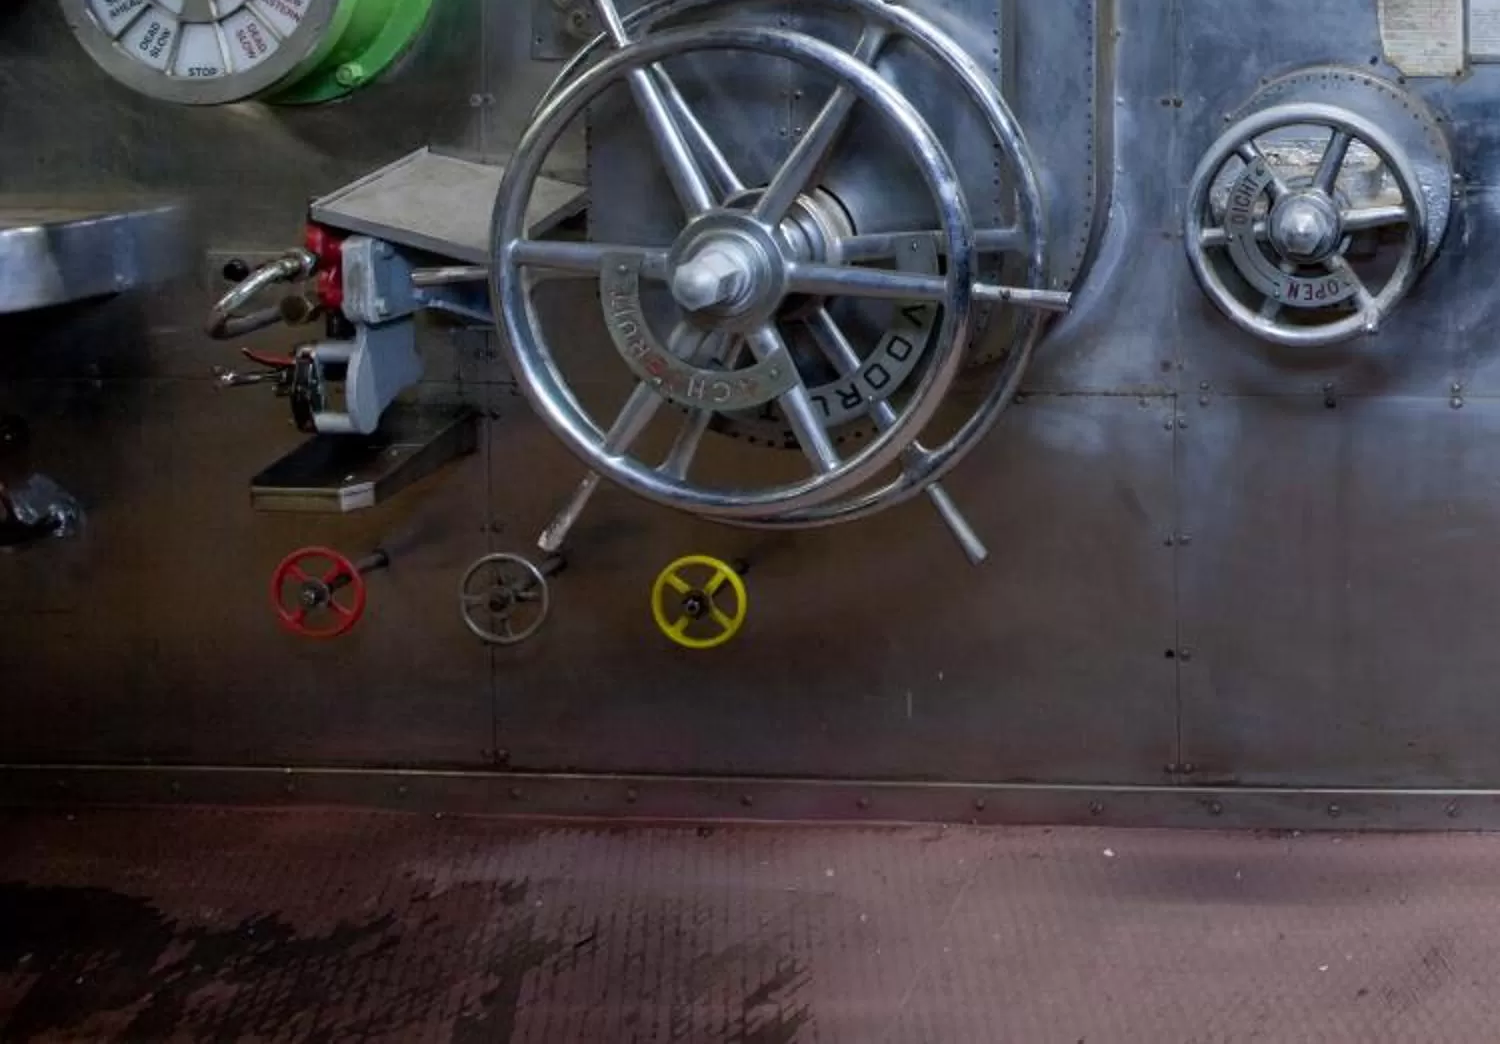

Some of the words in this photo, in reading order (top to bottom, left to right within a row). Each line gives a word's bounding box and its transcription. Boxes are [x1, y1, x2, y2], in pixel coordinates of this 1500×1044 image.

[139, 21, 161, 51] DEAD
[149, 28, 172, 59] SLOW
[235, 28, 257, 59] SLOW
[247, 22, 268, 54] DEAD
[187, 67, 217, 77] STOP
[1231, 174, 1260, 225] DICHT
[1287, 279, 1339, 301] OPEN
